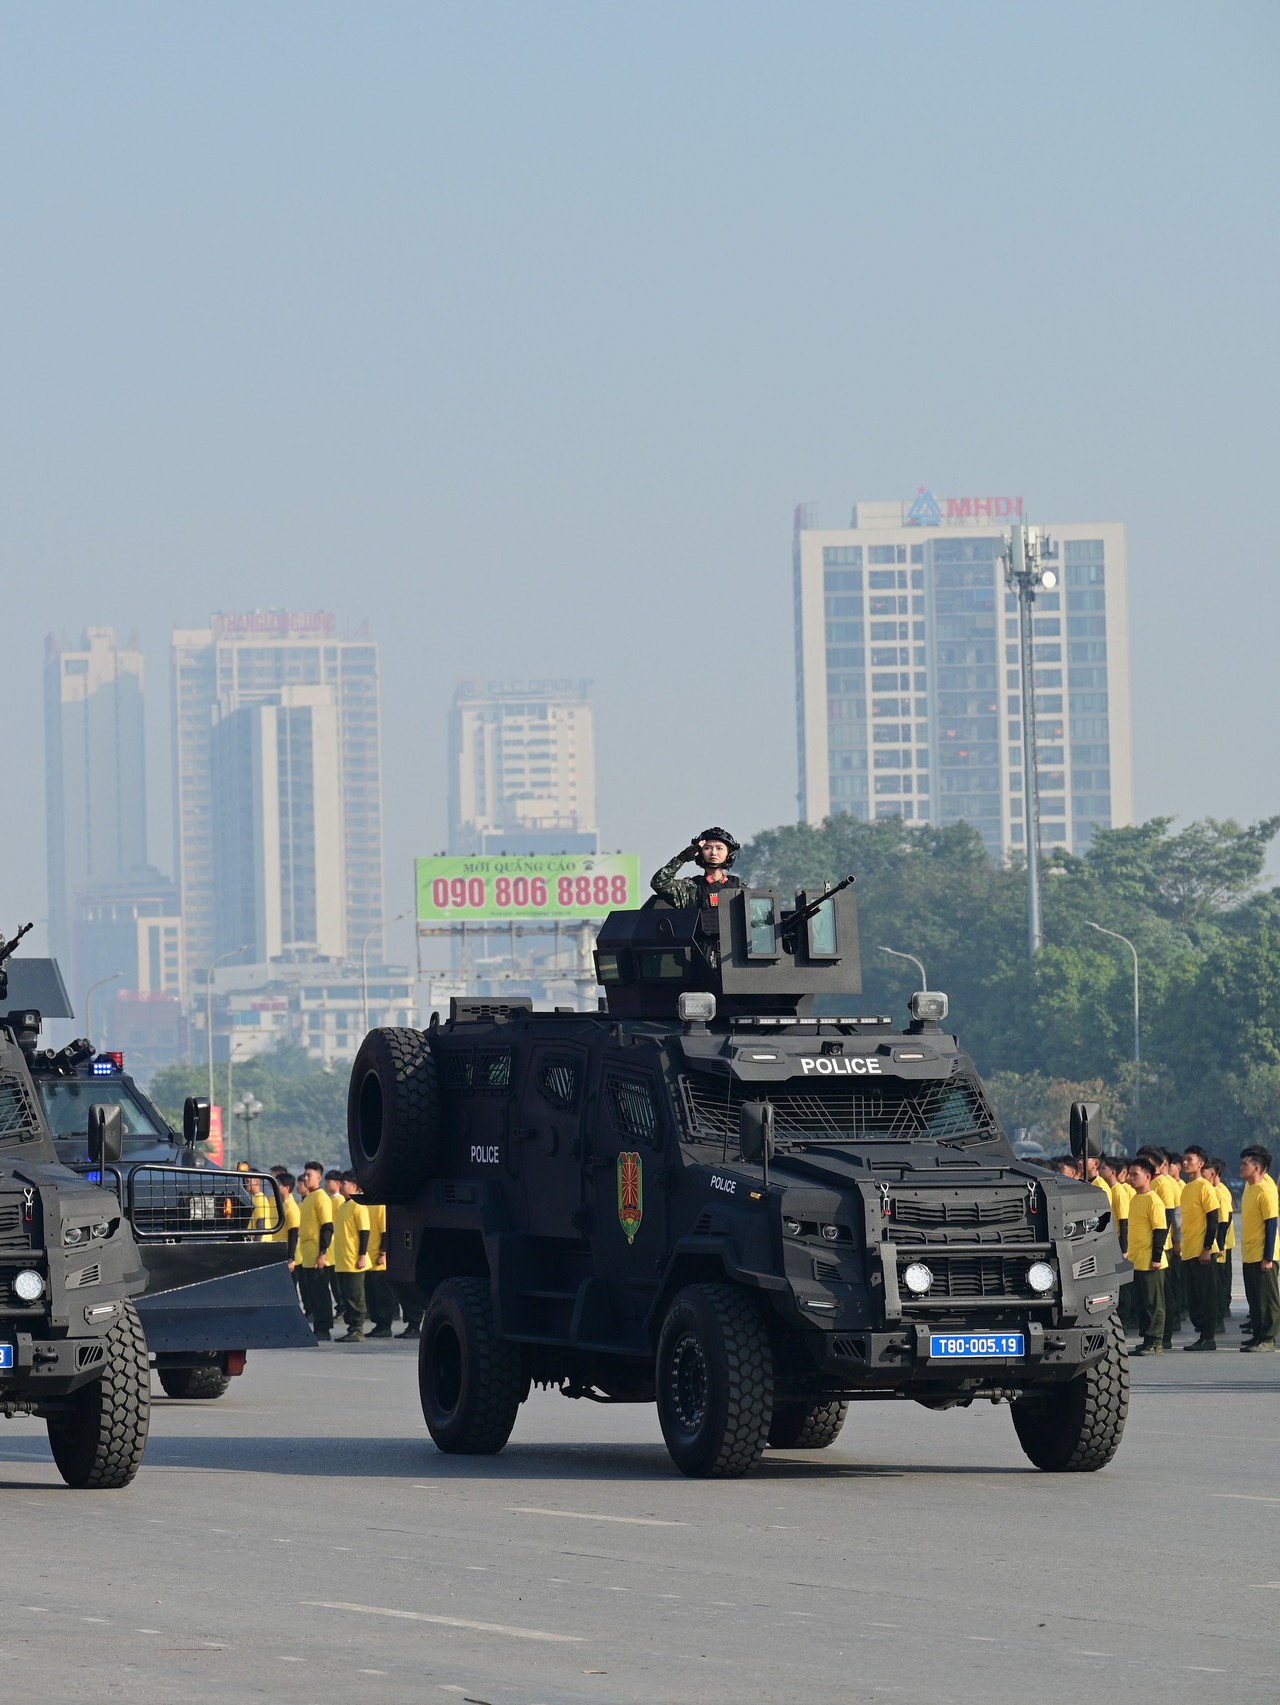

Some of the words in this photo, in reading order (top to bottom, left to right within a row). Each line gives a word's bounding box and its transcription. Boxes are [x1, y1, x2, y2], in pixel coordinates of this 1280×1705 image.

[947, 496, 1023, 517] MHDI
[432, 876, 486, 908] 090
[495, 876, 547, 907] 806
[557, 875, 628, 906] 8888
[800, 1058, 882, 1074] POLICE
[470, 1145, 499, 1163] POLICE
[710, 1174, 737, 1194] POLICE
[939, 1338, 1017, 1354] T80-005.19
